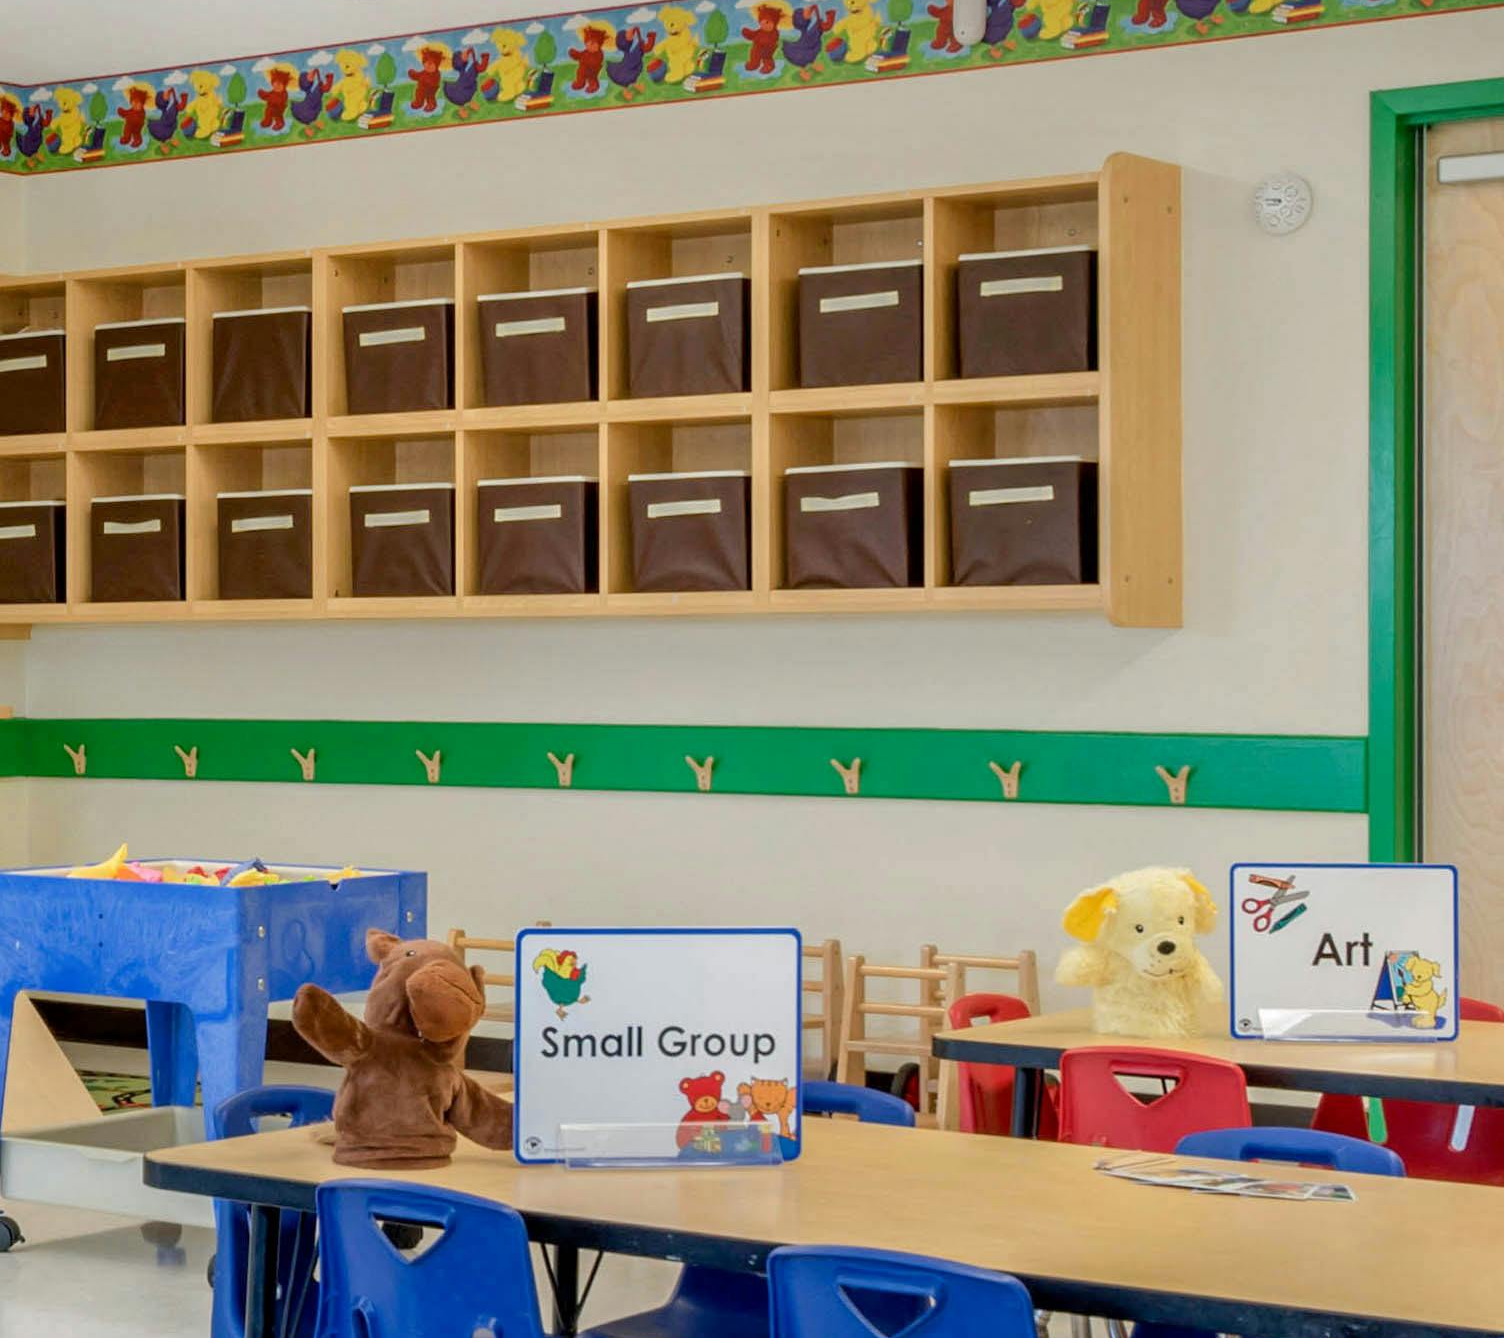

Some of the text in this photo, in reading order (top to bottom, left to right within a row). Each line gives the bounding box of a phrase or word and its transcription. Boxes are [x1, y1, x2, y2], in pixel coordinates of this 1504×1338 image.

[1312, 932, 1374, 967] Art
[540, 1026, 776, 1063] Small Group
